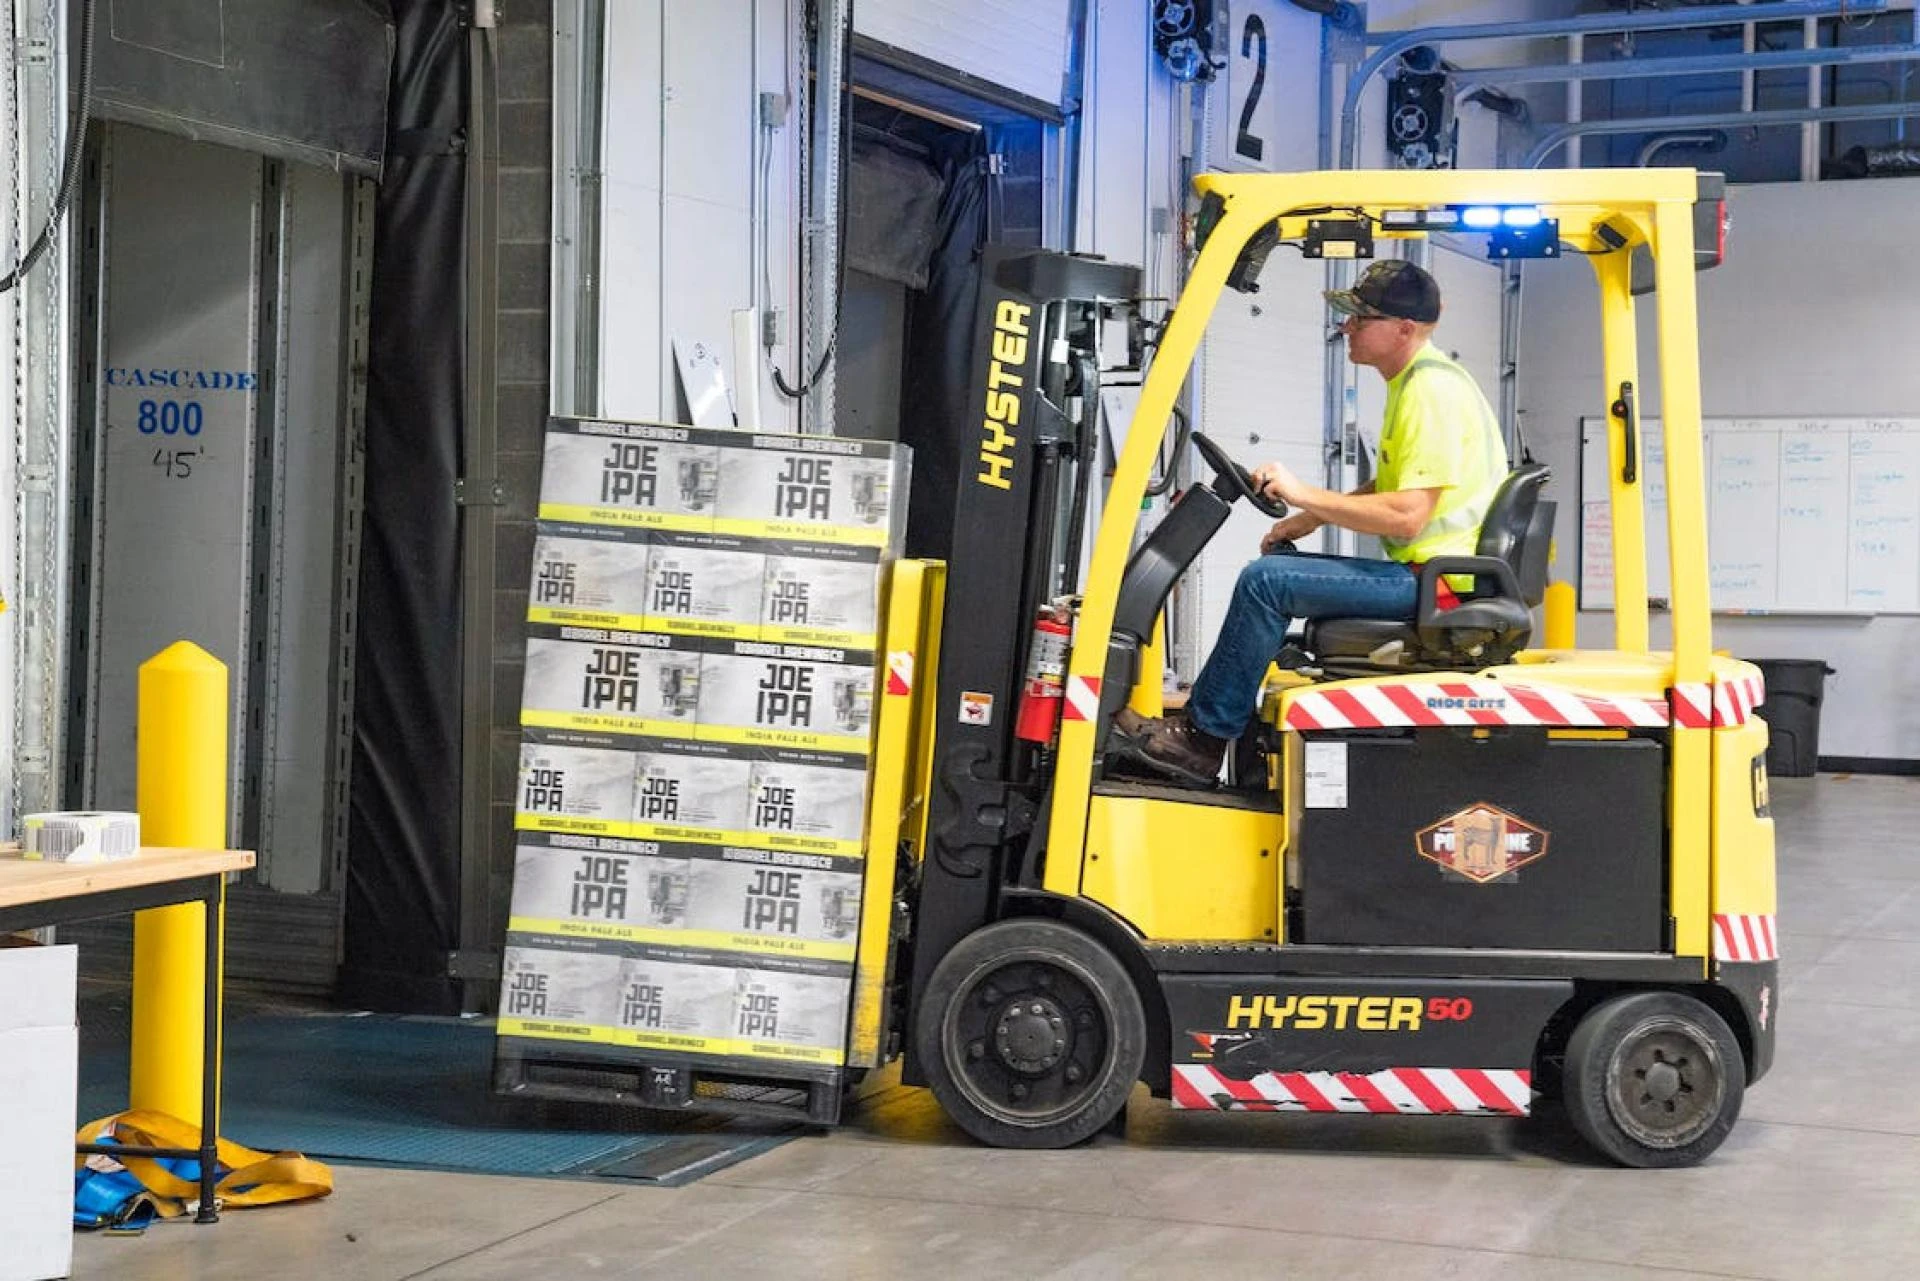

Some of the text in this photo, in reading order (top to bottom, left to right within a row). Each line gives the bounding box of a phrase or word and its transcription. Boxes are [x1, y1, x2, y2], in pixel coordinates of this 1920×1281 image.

[1236, 14, 1266, 161] 2
[103, 368, 258, 391] CASCADE
[977, 298, 1031, 491] HYSTER
[138, 400, 203, 436] 800
[604, 443, 658, 471] JOE
[778, 457, 832, 486] JOE
[600, 470, 657, 506] IPA
[775, 485, 831, 519] IPA
[539, 562, 577, 580] JOE
[655, 571, 693, 590] JOE
[537, 580, 575, 604] IPA
[653, 590, 691, 614] IPA
[772, 581, 810, 600] JOE
[769, 600, 808, 624] IPA
[586, 649, 641, 677] JOE
[759, 664, 814, 692] JOE
[582, 676, 639, 712] IPA
[756, 691, 812, 727] IPA
[527, 769, 565, 788] JOE
[642, 778, 680, 797] JOE
[525, 788, 563, 812] IPA
[640, 796, 678, 821] IPA
[758, 787, 796, 806] JOE
[755, 806, 793, 830] IPA
[575, 856, 630, 885] JOE
[747, 870, 802, 899] JOE
[571, 883, 627, 919] IPA
[743, 897, 799, 934] IPA
[511, 973, 549, 992] JOE
[625, 984, 664, 1003] JOE
[508, 991, 547, 1016] IPA
[623, 1003, 662, 1027] IPA
[741, 994, 779, 1013] JOE
[1226, 995, 1473, 1031] HYSTER 50
[739, 1013, 777, 1037] IPA
